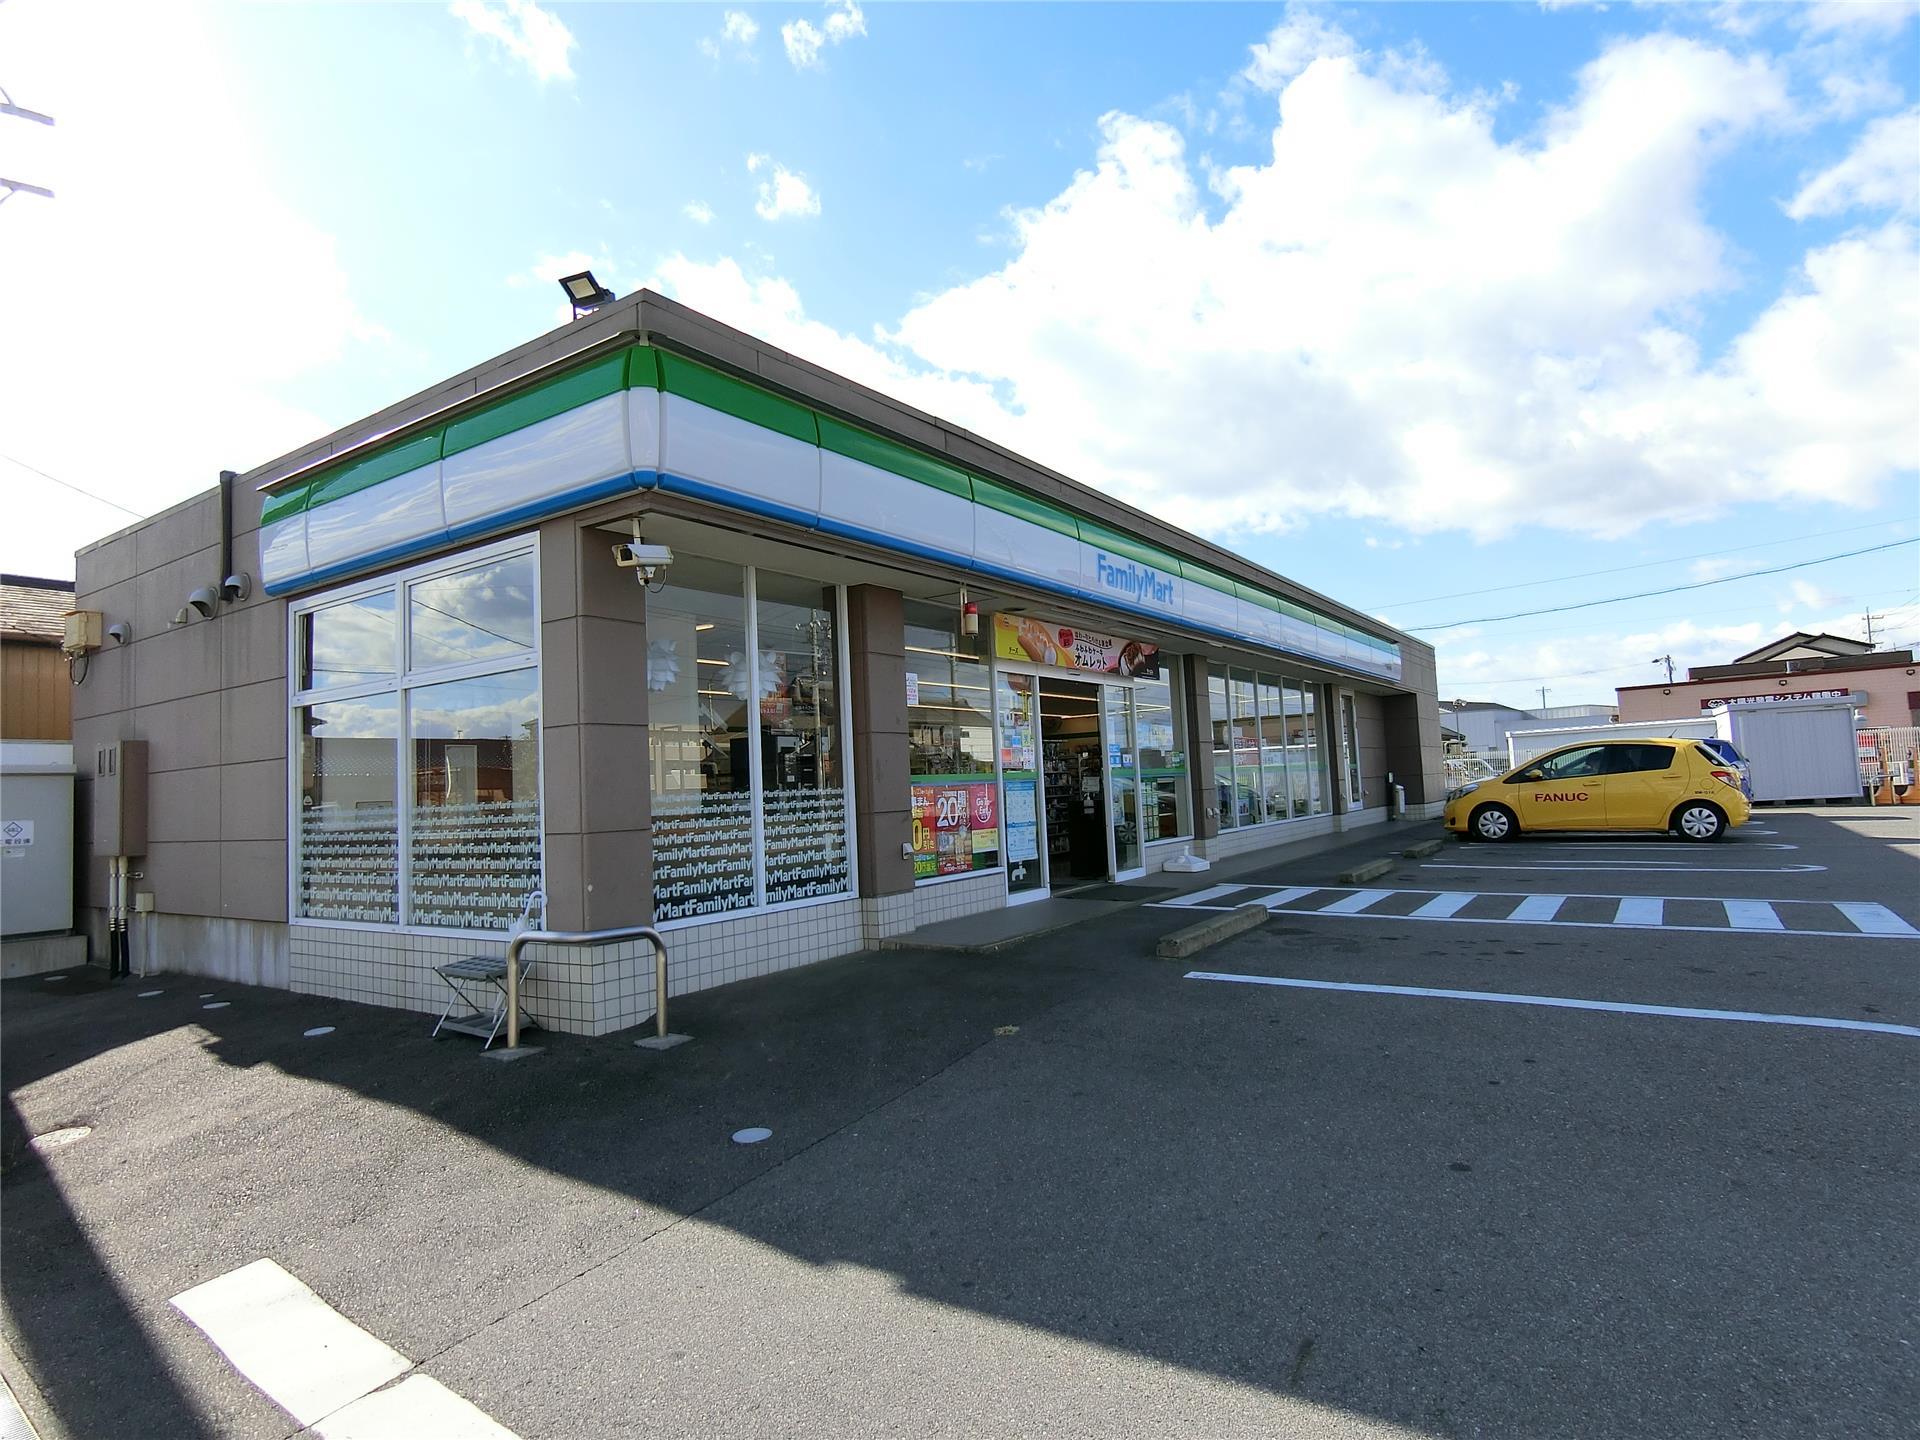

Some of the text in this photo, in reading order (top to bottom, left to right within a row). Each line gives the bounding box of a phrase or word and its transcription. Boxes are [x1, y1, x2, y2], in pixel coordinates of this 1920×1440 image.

[1097, 553, 1174, 605] FamilyMart
[1074, 652, 1107, 670] オムレット
[1535, 792, 1589, 802] FANUC
